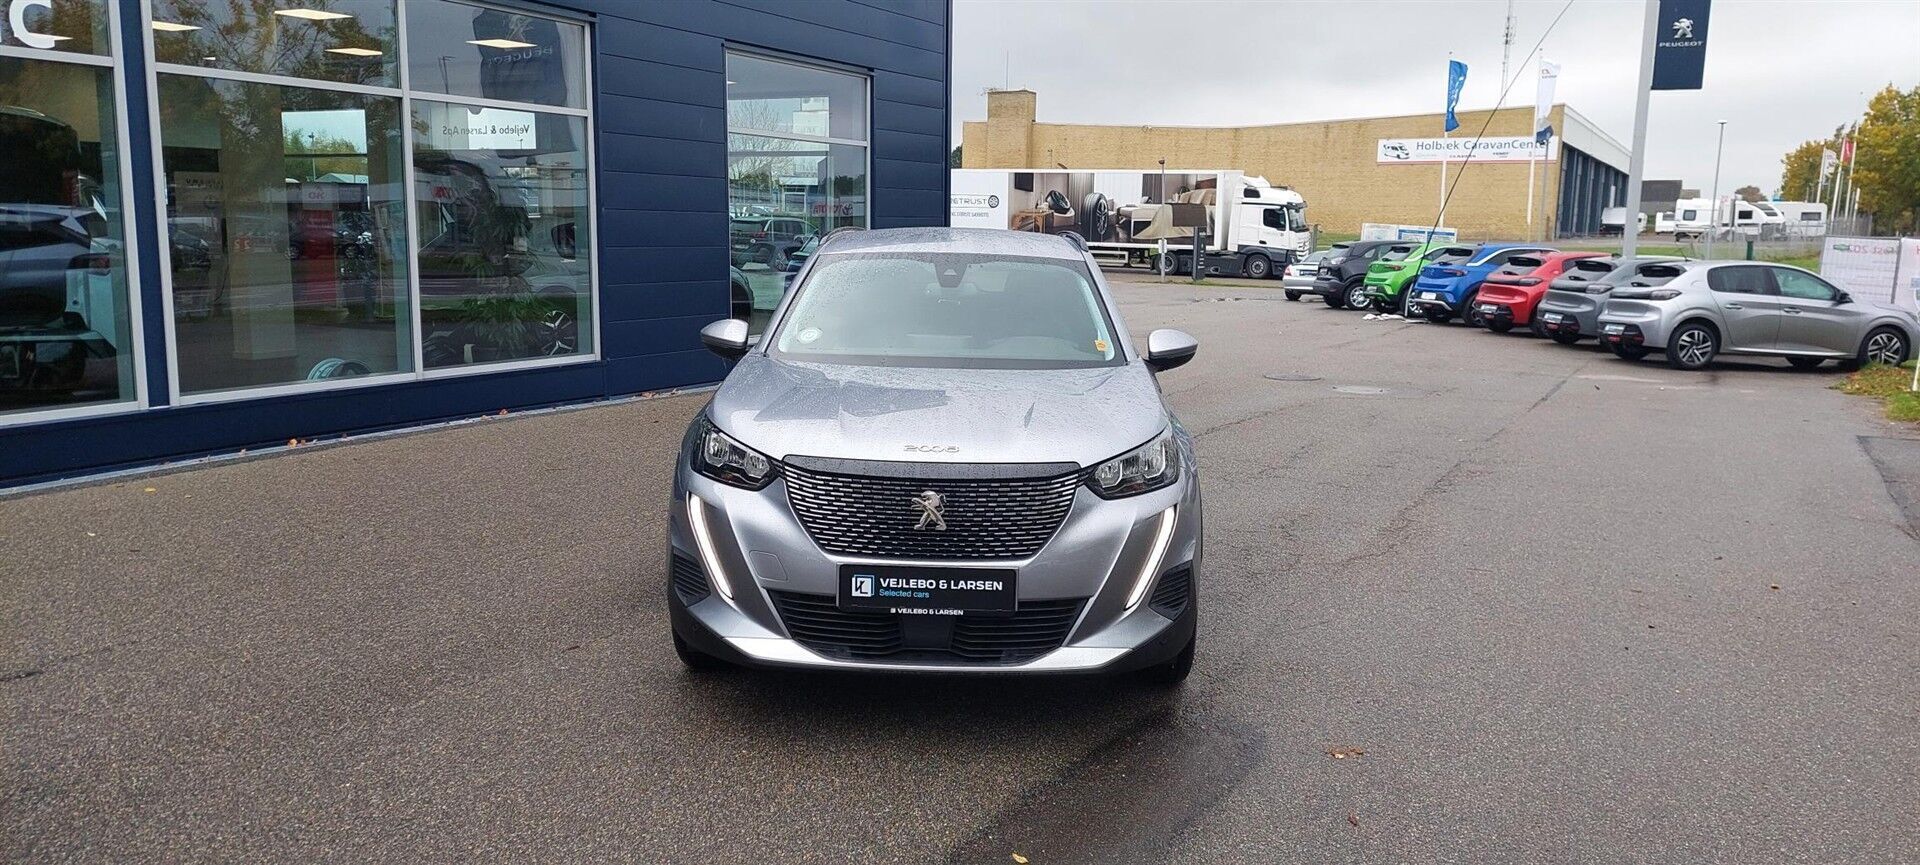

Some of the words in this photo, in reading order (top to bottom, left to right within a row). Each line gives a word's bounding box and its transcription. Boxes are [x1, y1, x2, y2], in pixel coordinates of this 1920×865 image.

[1659, 40, 1704, 48] PEUGEOT
[904, 445, 960, 453] 2008
[879, 577, 936, 590] VEJLEBO
[938, 579, 948, 590] &
[950, 580, 1003, 591] LARSEN
[879, 588, 912, 598] Selected
[913, 591, 930, 599] cars
[897, 607, 928, 615] VEJLEBO
